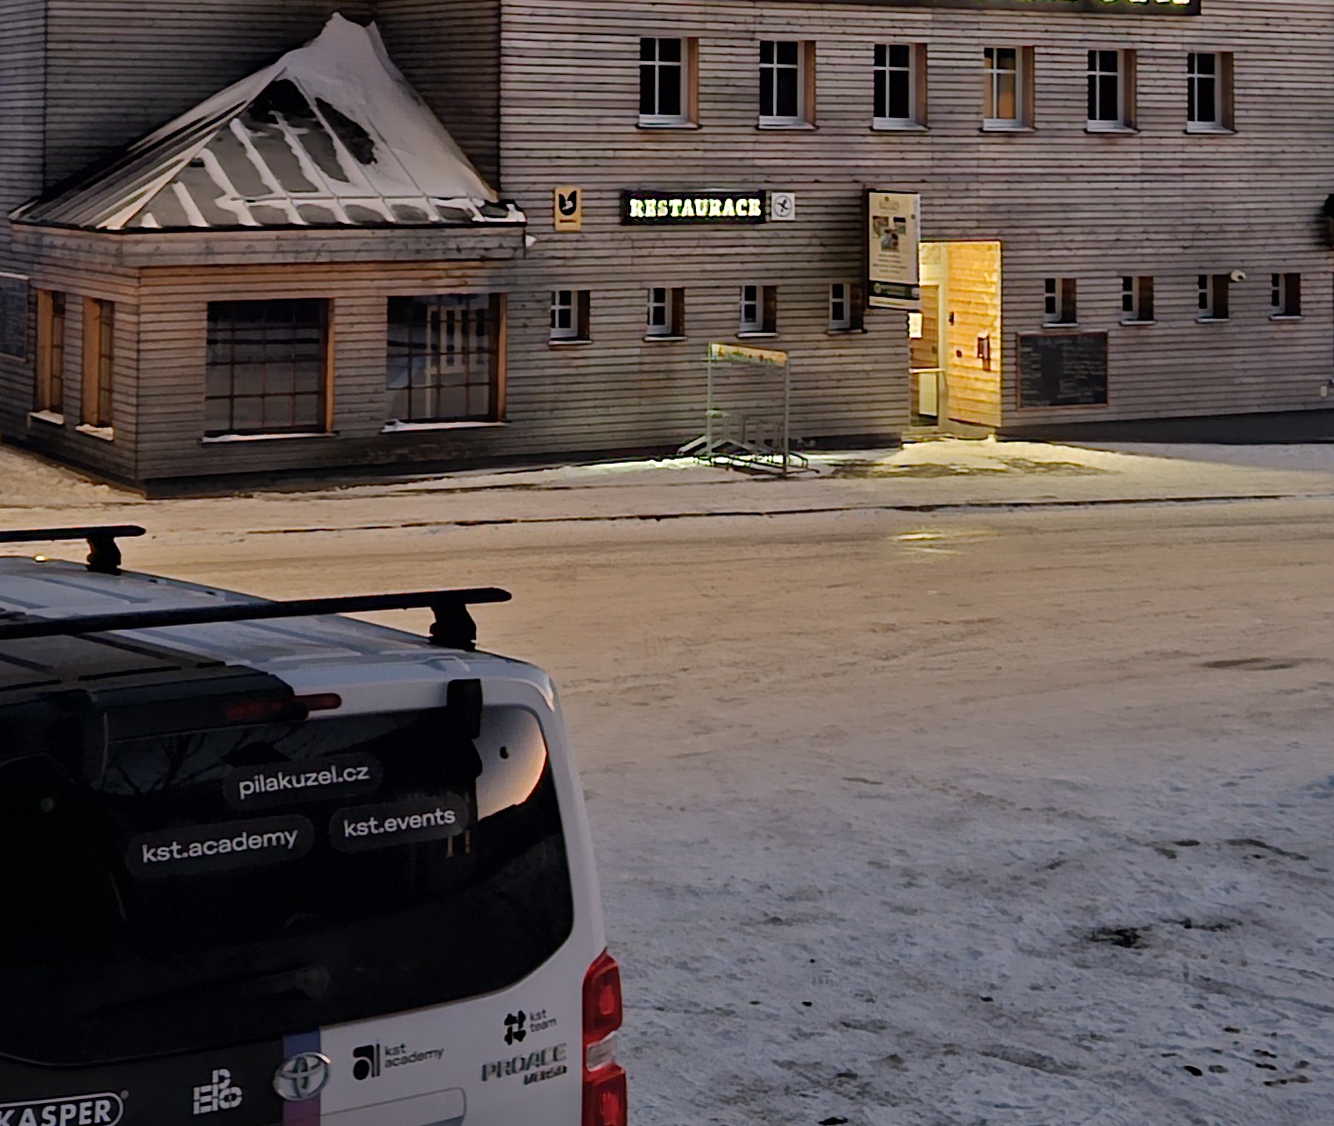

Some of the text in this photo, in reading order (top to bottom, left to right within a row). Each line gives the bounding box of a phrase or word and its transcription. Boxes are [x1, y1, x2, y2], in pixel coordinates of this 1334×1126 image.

[629, 198, 762, 218] RESTAURACE
[238, 764, 371, 800] pilakuzel.cz
[342, 805, 456, 839] kst.events
[141, 825, 299, 865] kst.academy
[530, 1009, 547, 1021] kst
[530, 1018, 557, 1033] team
[384, 1043, 407, 1056] kst
[384, 1048, 444, 1069] academy
[481, 1042, 568, 1082] PROACE
